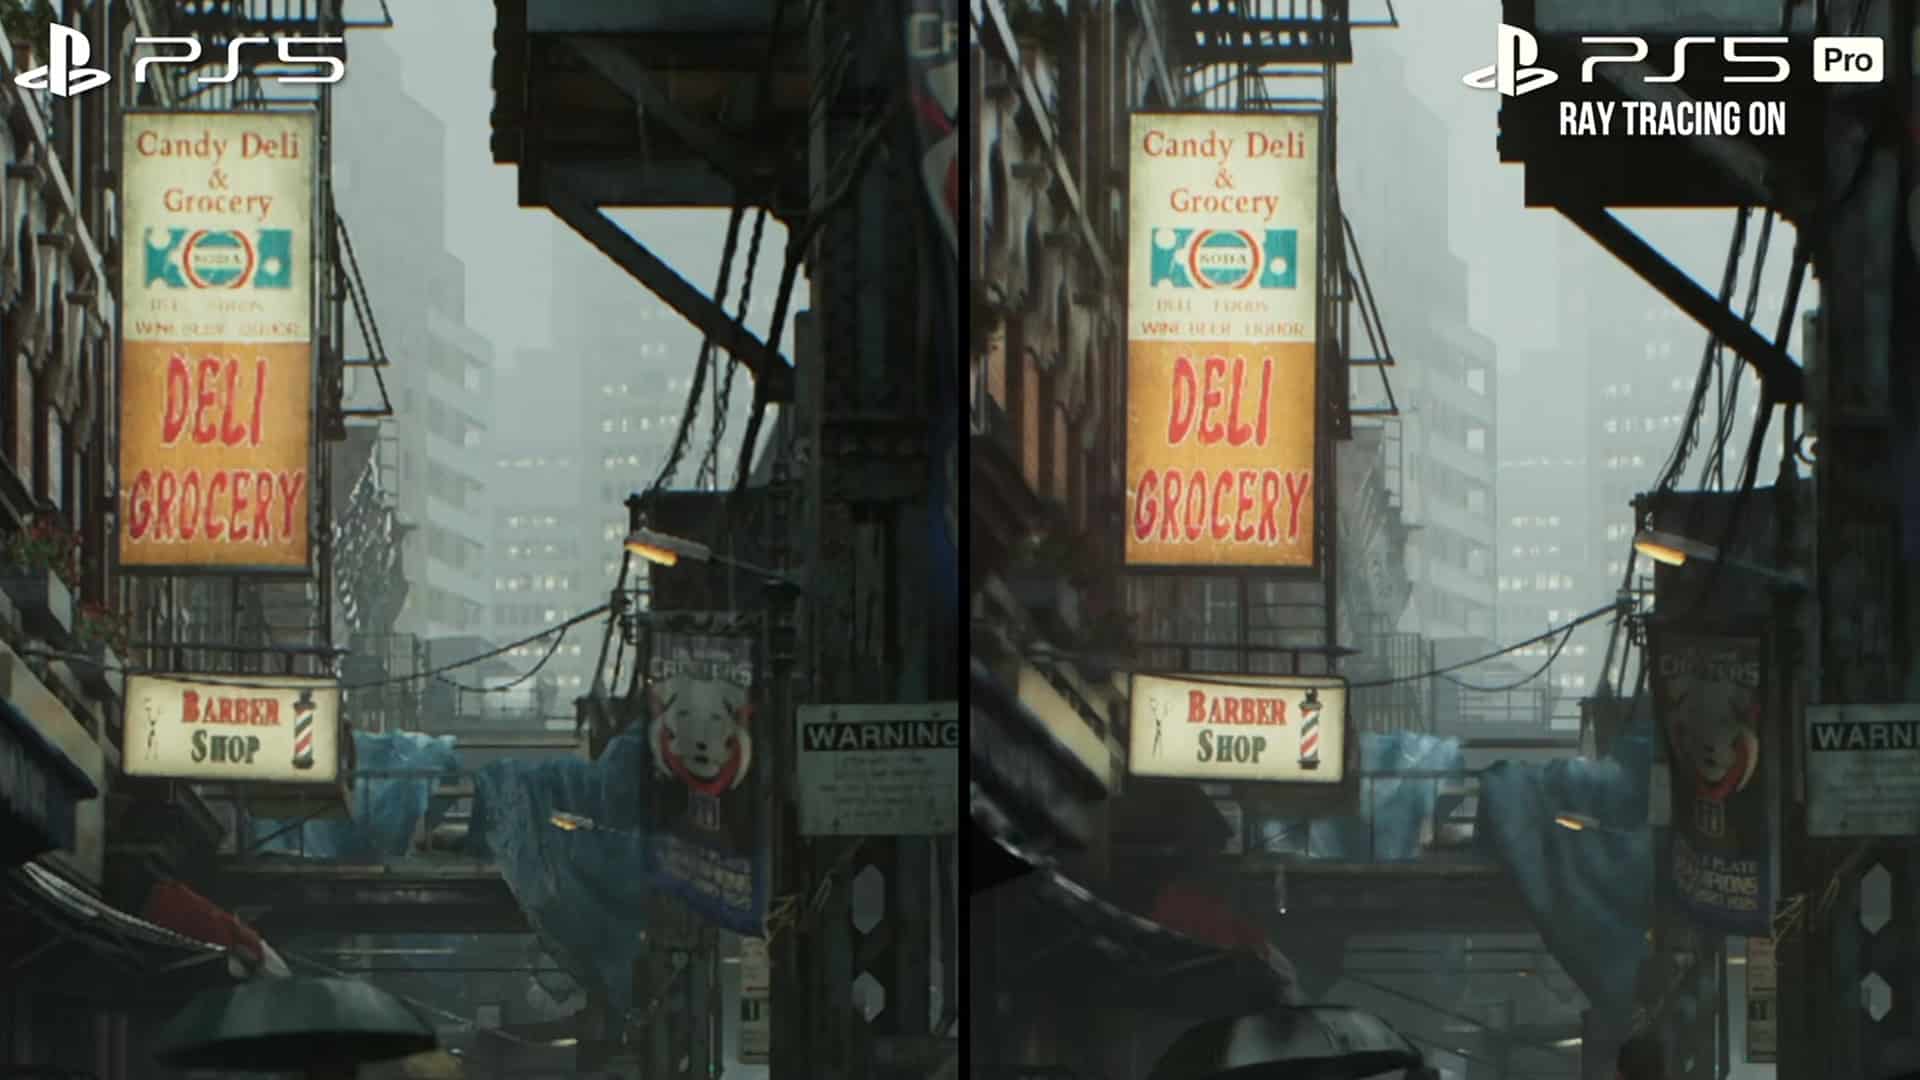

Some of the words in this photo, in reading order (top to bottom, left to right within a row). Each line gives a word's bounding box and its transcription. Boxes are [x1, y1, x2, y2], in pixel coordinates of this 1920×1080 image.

[137, 129, 228, 165] Candy
[241, 130, 299, 160] Deli
[1143, 128, 1233, 165] Candy
[1247, 130, 1305, 159] Deli
[208, 168, 229, 190] &
[1215, 168, 1234, 189] &
[164, 188, 273, 222] Grocery
[1170, 188, 1279, 222] Grocery
[1200, 253, 1247, 265] SODA
[162, 355, 268, 447] DELI
[1167, 355, 1273, 447] DELI
[128, 468, 305, 542] GROCERY
[1134, 468, 1311, 543] GROCERY
[181, 689, 281, 726] BARBER
[1187, 689, 1287, 726] BARBER
[191, 729, 261, 764] SHOP
[808, 722, 958, 749] WARNING
[1197, 729, 1267, 764] SHOP
